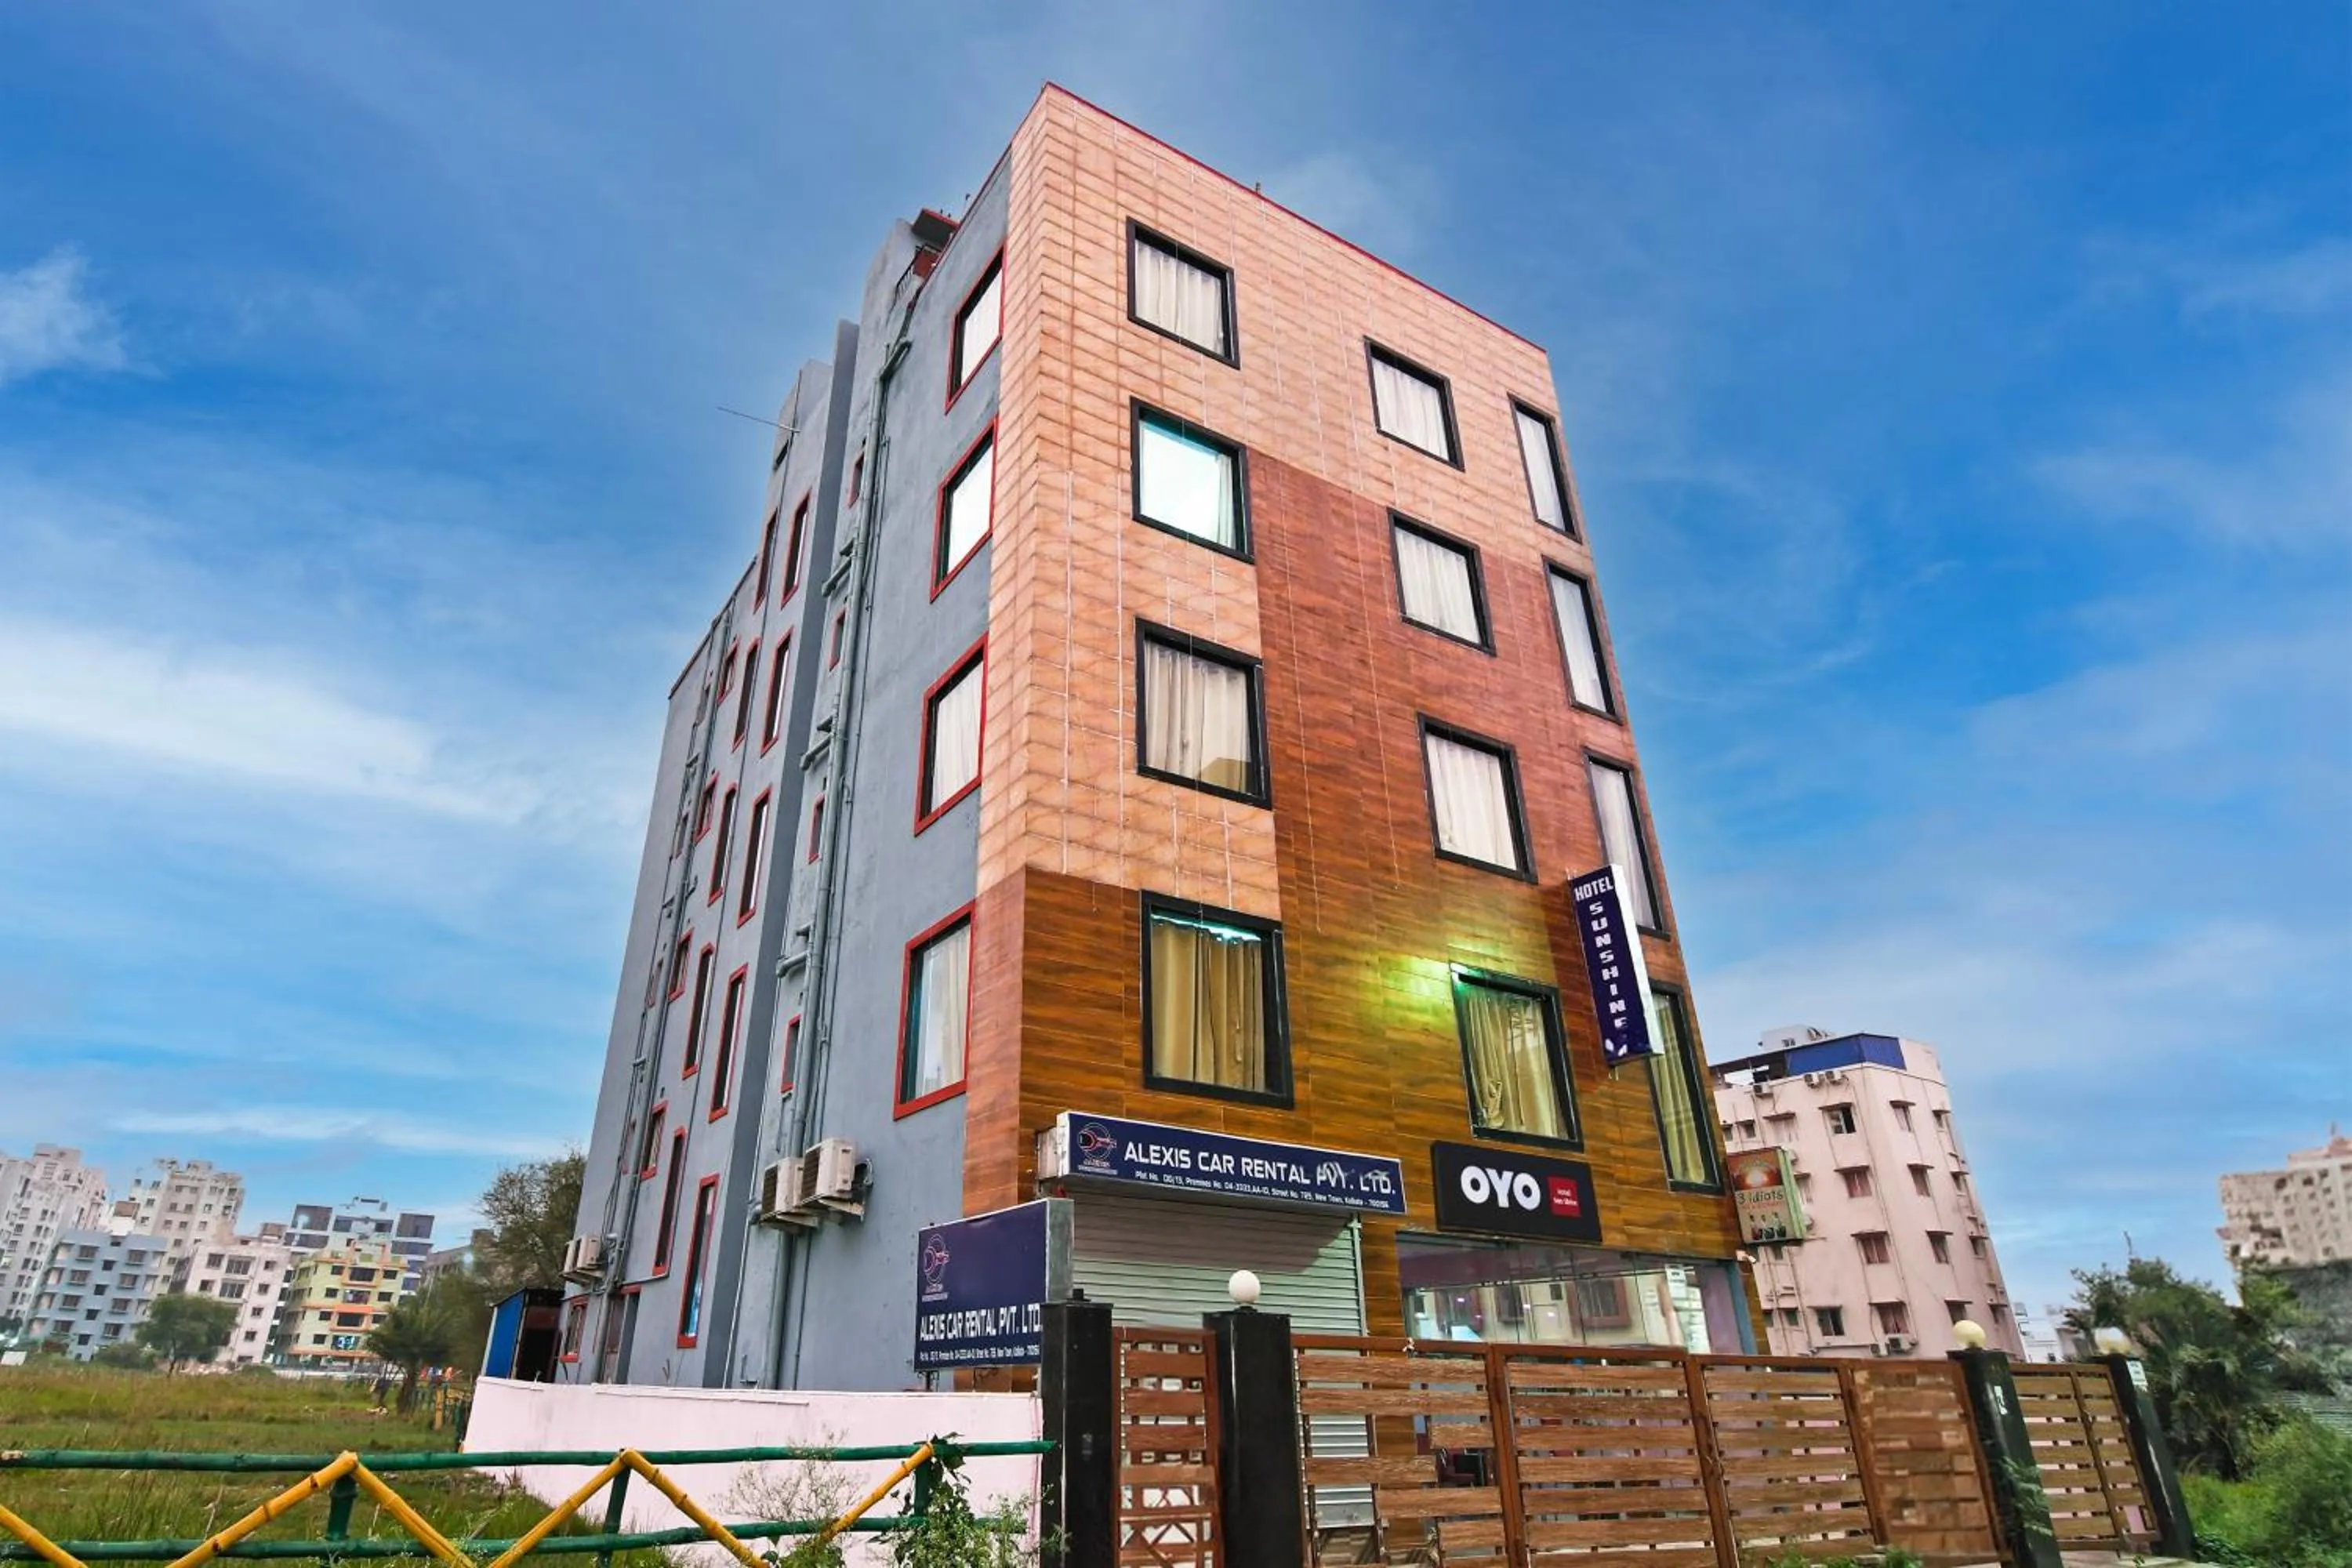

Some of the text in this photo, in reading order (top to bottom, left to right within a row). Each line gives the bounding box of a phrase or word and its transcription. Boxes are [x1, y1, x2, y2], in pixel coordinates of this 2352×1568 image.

[1574, 877, 1613, 902] HOTEL
[1589, 901, 1628, 1029] SUNSHINE
[1124, 1142, 1191, 1169] ALEXIS
[1198, 1152, 1235, 1174] CAR
[1241, 1157, 1311, 1185] RENTAL
[1359, 1171, 1396, 1194] LTD.
[1461, 1166, 1541, 1210] OYO
[1737, 1192, 1745, 1205] 3
[920, 1314, 945, 1341] ALEXIS
[947, 1312, 963, 1339] CAR
[964, 1308, 996, 1338] RENTAL
[999, 1306, 1019, 1336] PVT.
